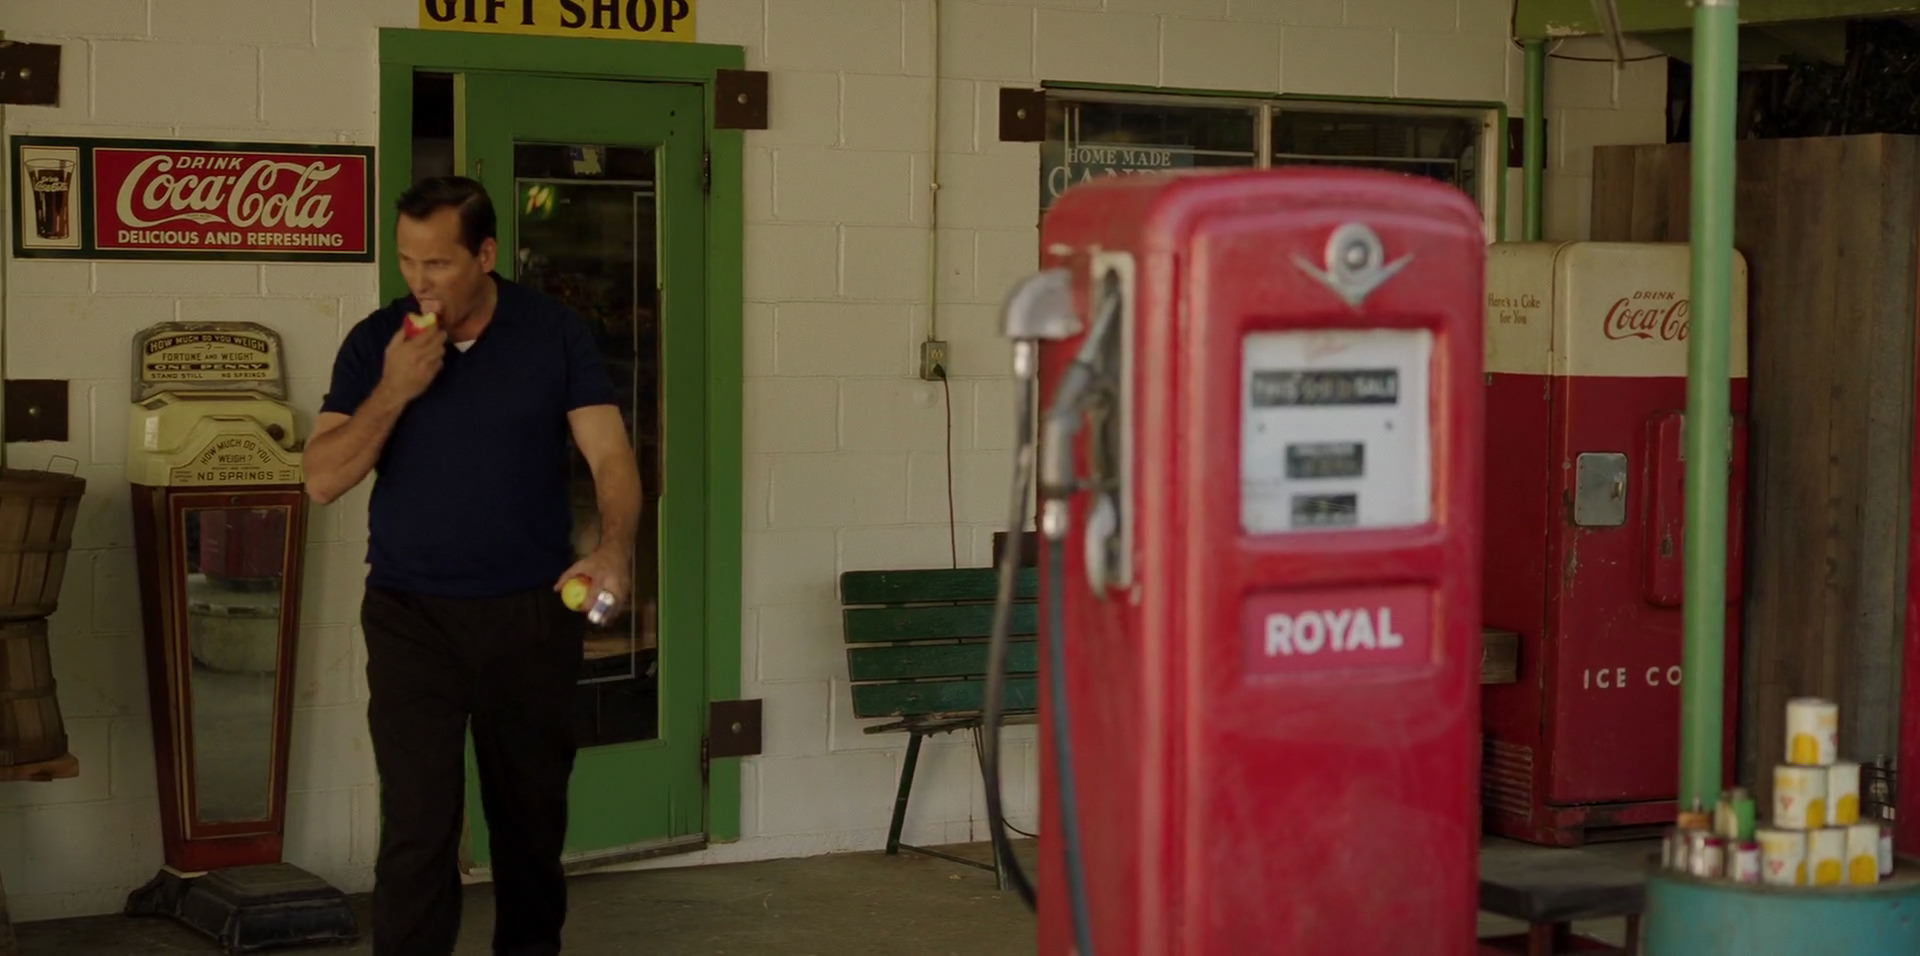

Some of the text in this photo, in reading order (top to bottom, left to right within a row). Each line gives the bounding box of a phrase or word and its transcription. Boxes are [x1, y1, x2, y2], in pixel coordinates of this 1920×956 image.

[560, 0, 690, 33] SHOP
[176, 155, 244, 171] DRINK
[1069, 148, 1171, 167] HOME MADE
[116, 154, 342, 228] Coca-Cola
[117, 229, 344, 247] DELICIOUS AND REFRESHING
[1633, 291, 1676, 300] DRINK
[1603, 298, 1690, 341] Coca-Co
[150, 334, 266, 353] HOW MUCH DO YOU WEIGH
[154, 362, 264, 371] ONE PENNY
[162, 352, 201, 362] FORTUNE
[221, 352, 254, 361] WEIGHT
[201, 439, 272, 465] HOW MUCH DO YOU
[197, 471, 215, 481] NO
[218, 470, 274, 481] SPRINGS
[1264, 605, 1404, 658] ROYAL
[1583, 665, 1684, 690] ICE CO
